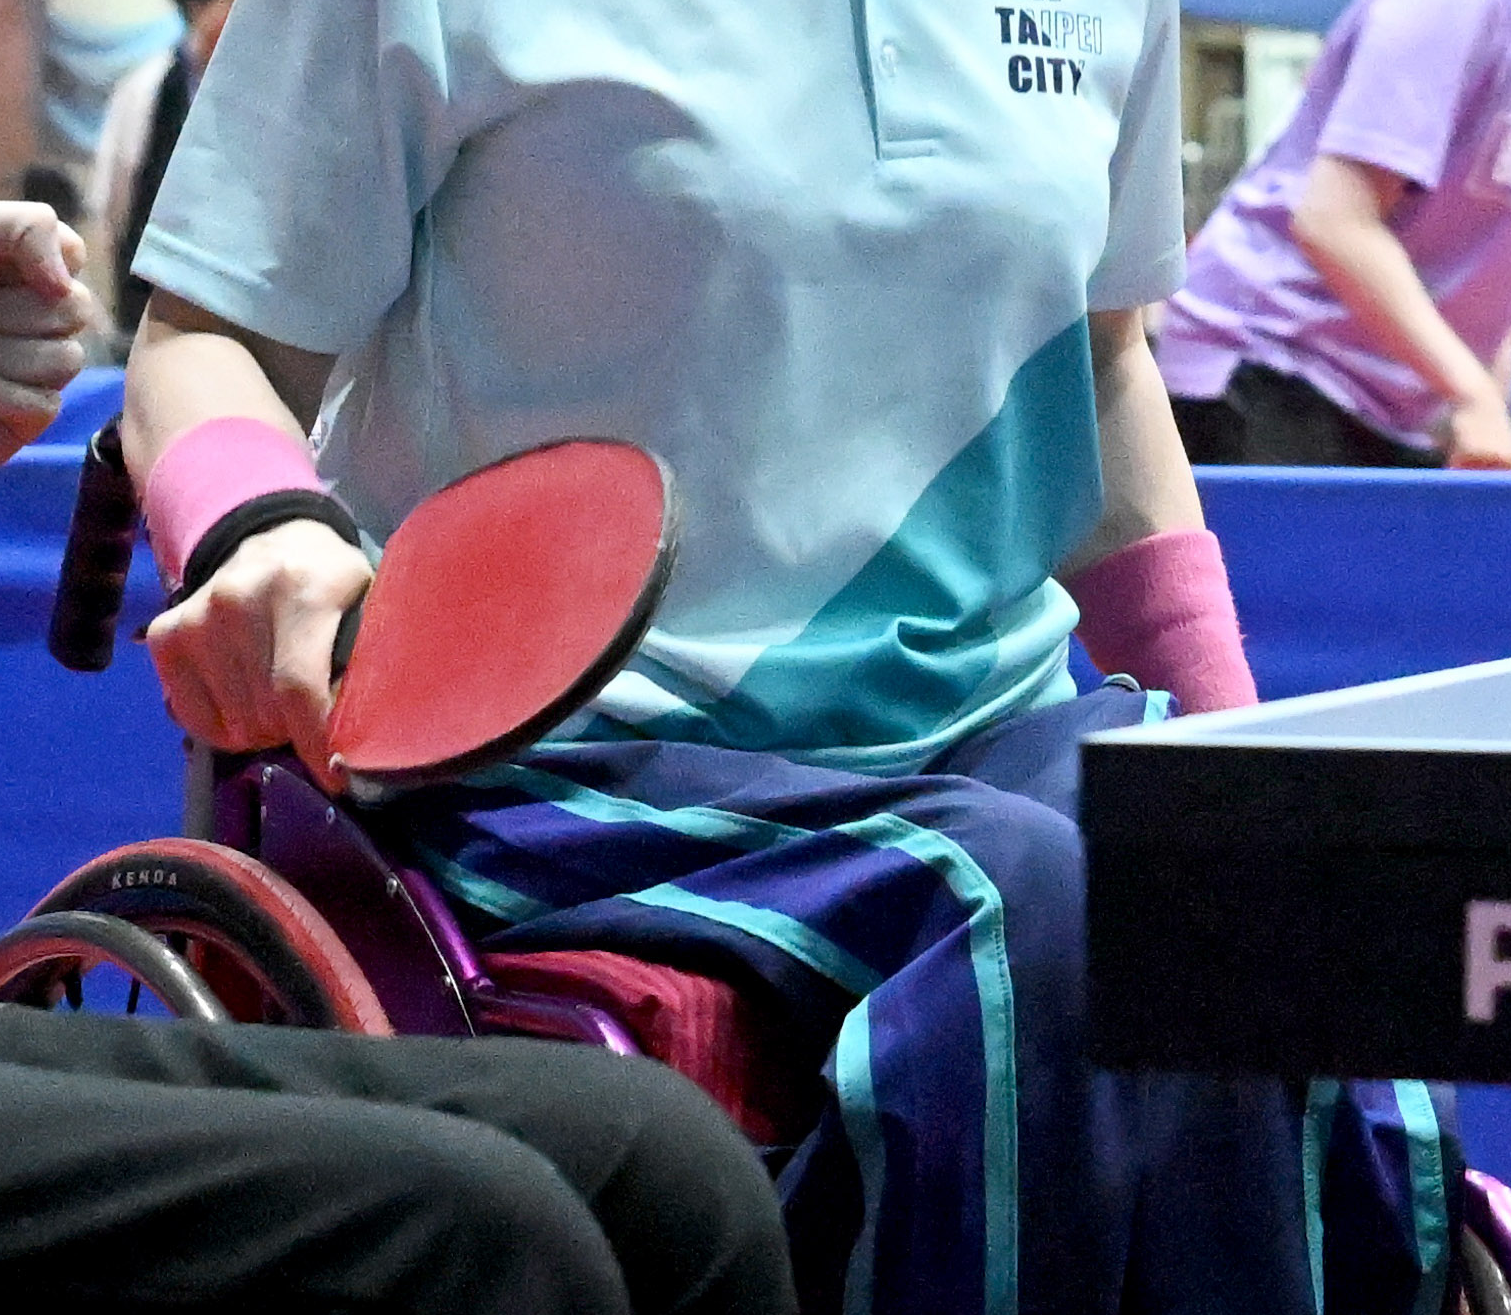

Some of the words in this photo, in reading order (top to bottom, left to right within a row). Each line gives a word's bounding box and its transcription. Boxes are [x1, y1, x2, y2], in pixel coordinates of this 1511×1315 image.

[994, 5, 1103, 56] TAIPEI
[1007, 53, 1086, 96] CITY
[111, 868, 177, 890] KENDA
